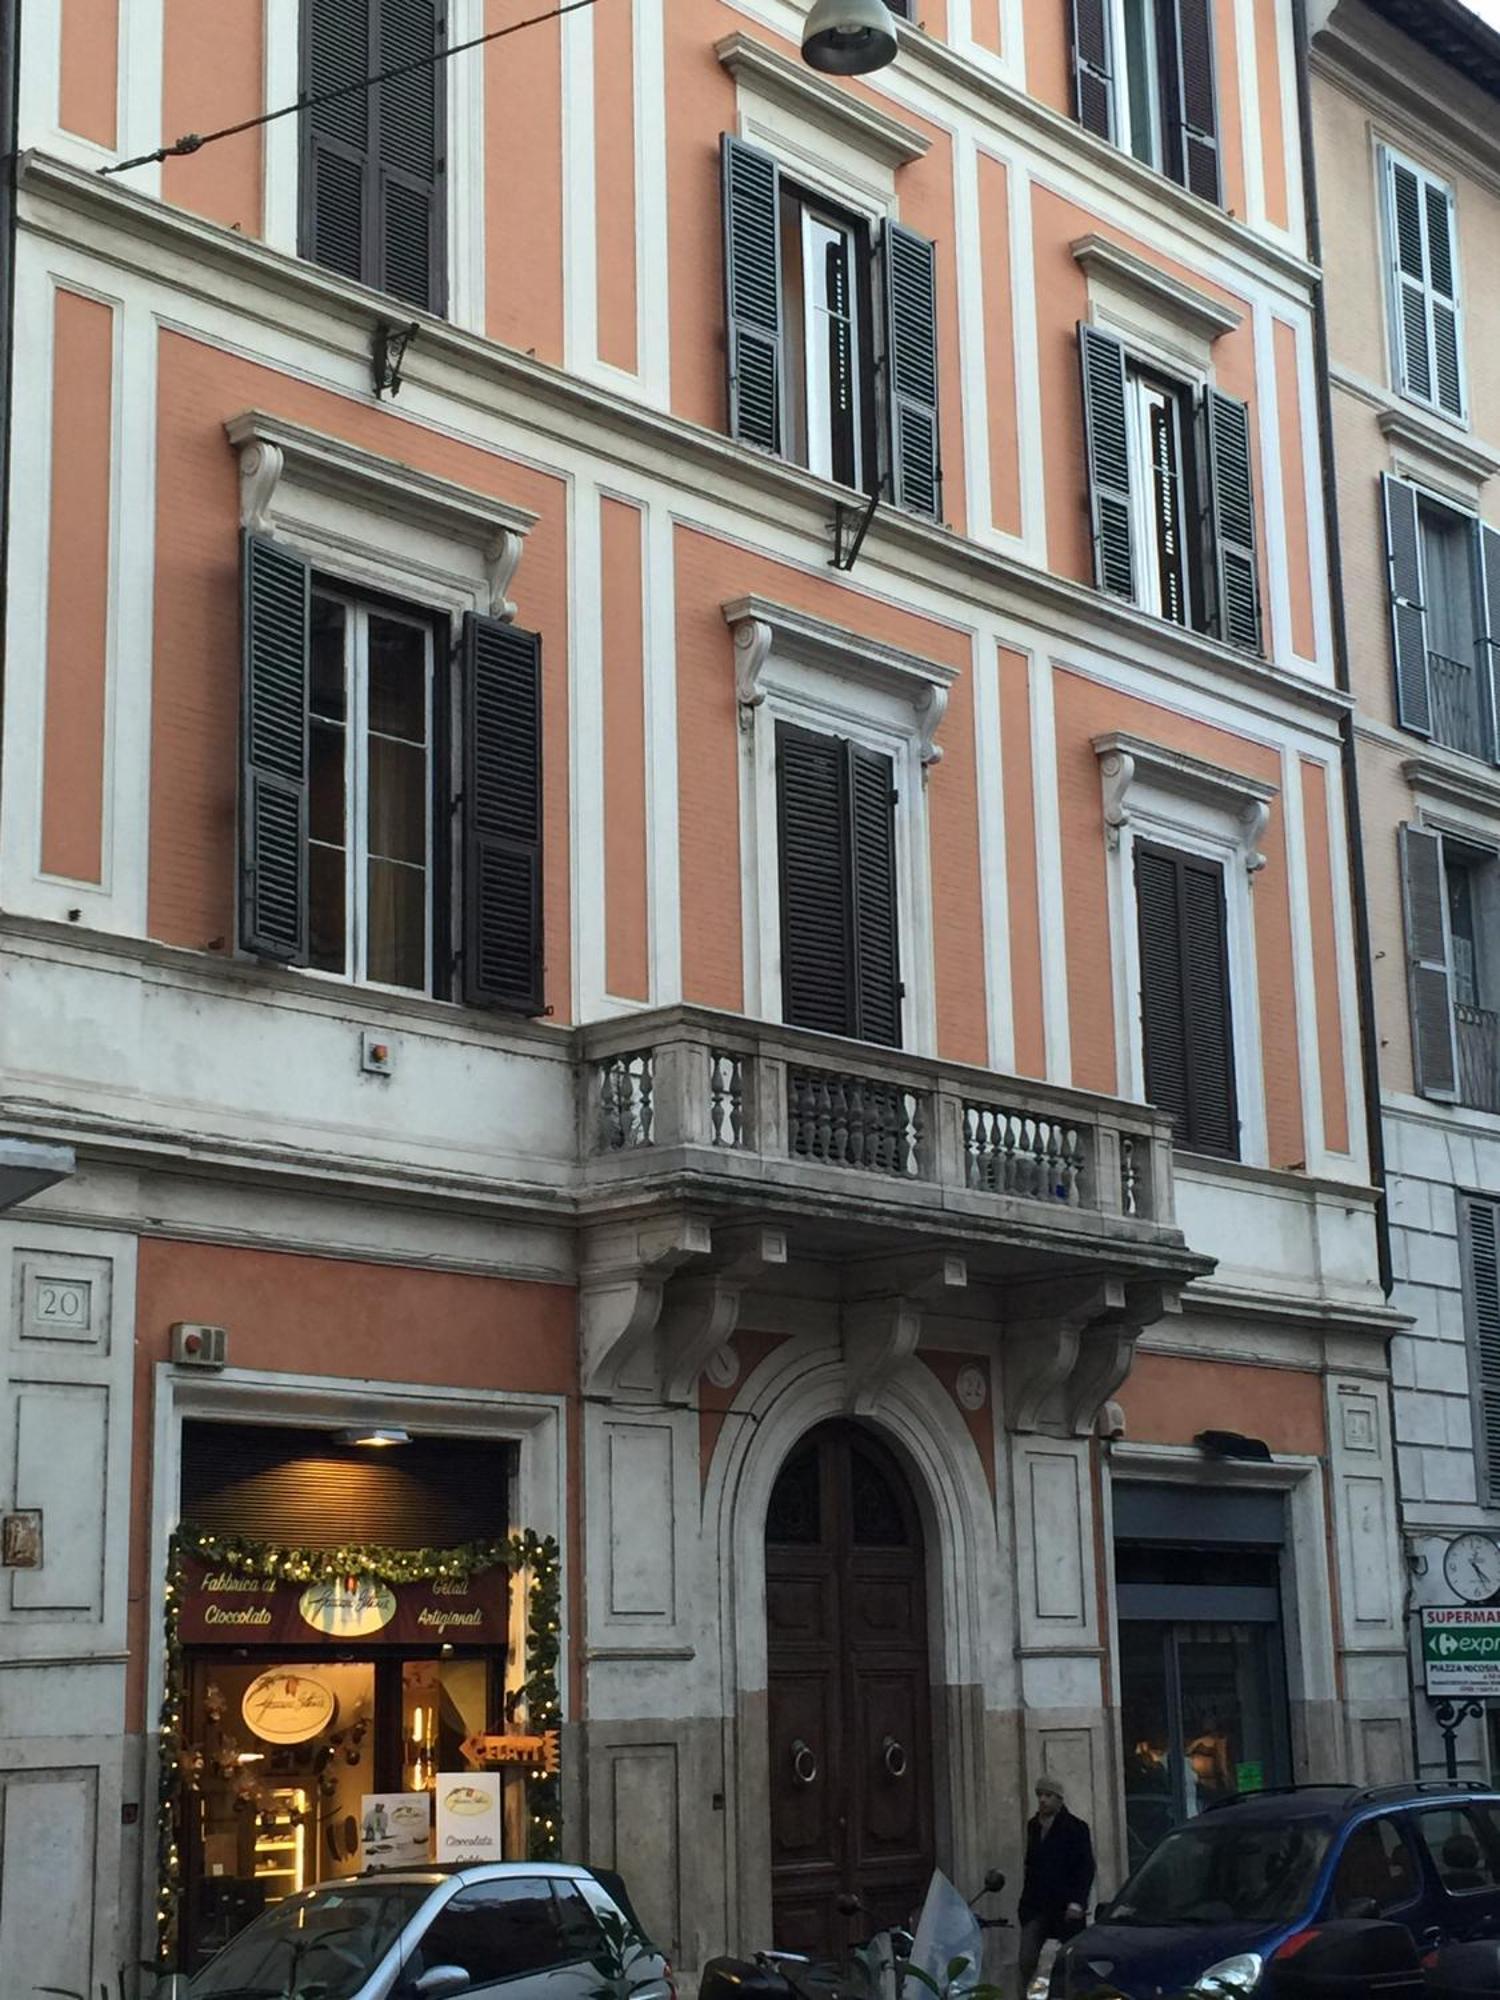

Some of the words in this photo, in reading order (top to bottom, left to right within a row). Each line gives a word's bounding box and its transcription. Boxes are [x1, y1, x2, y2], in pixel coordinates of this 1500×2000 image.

[43, 1289, 79, 1317] 20
[202, 1572, 259, 1592] Fabbrica
[204, 1604, 272, 1624] Cioccolato
[417, 1607, 482, 1634] Artigianali
[1430, 1663, 1462, 1673] PIAZZA
